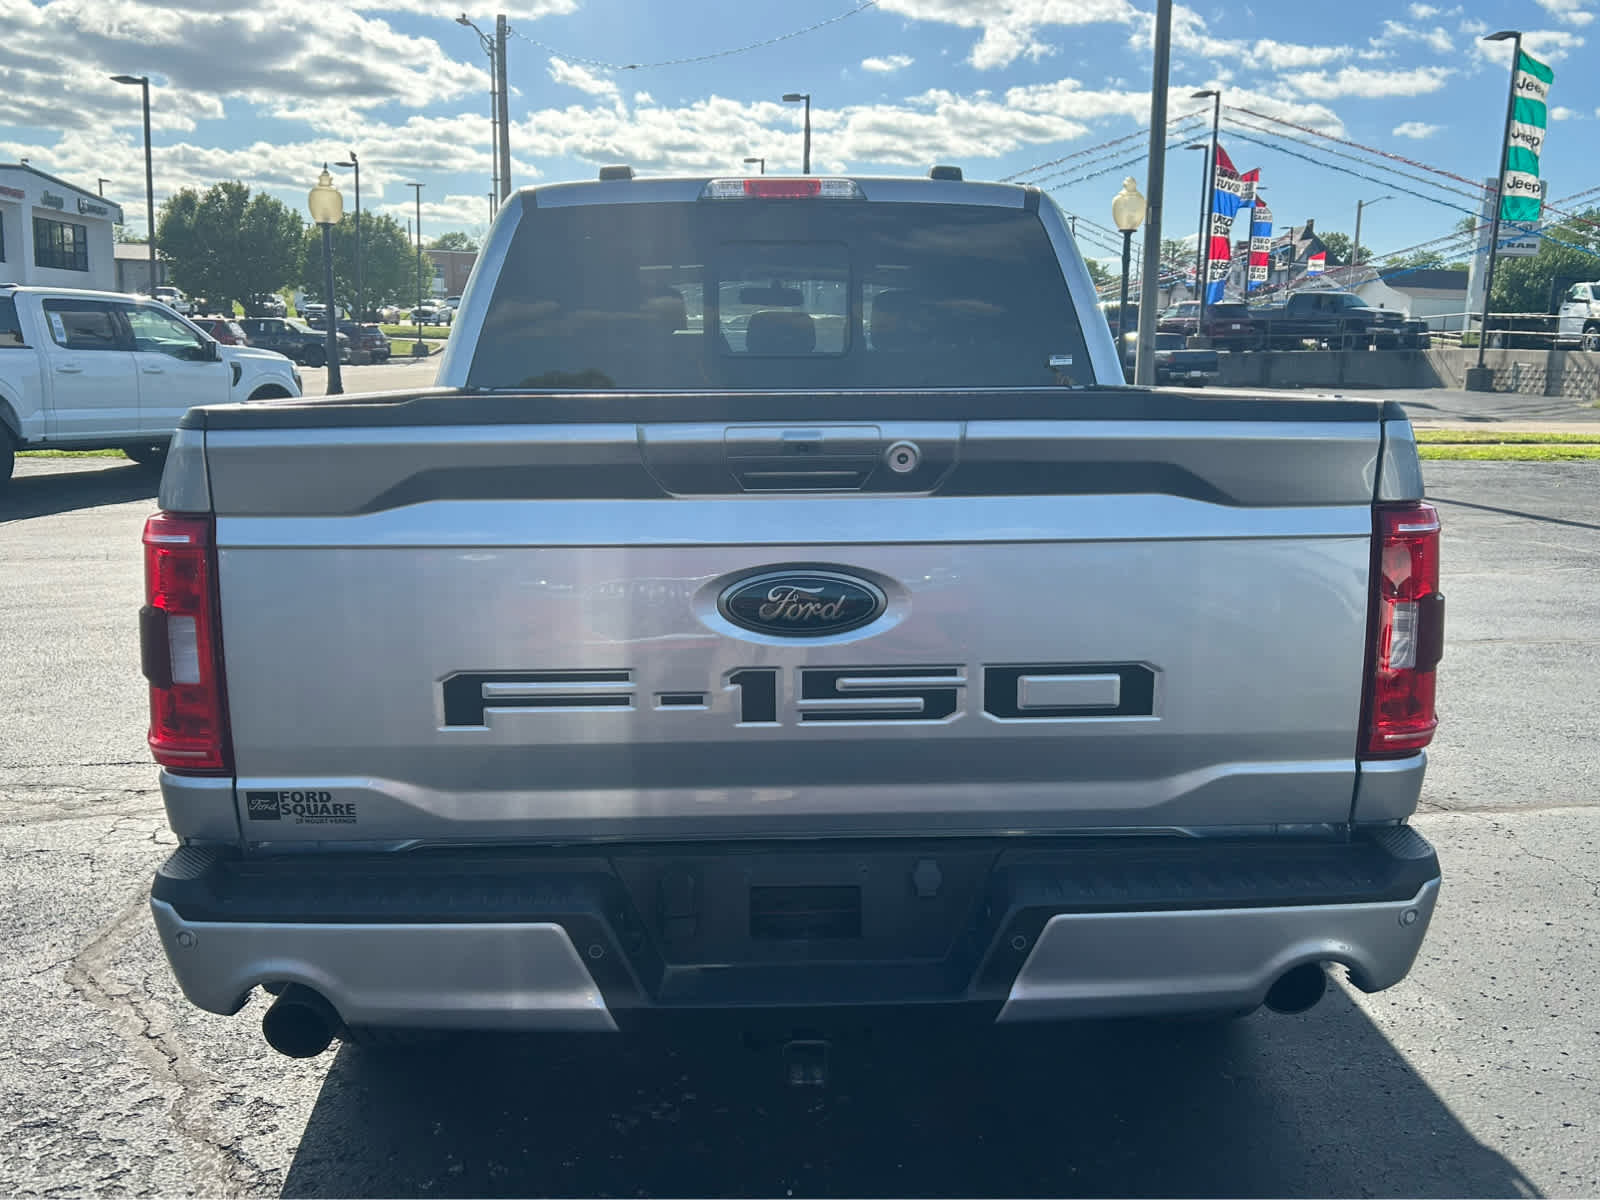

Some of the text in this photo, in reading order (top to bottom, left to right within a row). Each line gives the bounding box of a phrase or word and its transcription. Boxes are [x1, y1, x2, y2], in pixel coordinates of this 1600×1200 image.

[1511, 128, 1540, 149] Jeep
[1507, 176, 1541, 193] Jeep
[759, 585, 846, 619] Ford
[436, 663, 1162, 730] F-150
[249, 800, 279, 810] Ford
[280, 791, 332, 803] FORD
[281, 803, 356, 817] SQUARE
